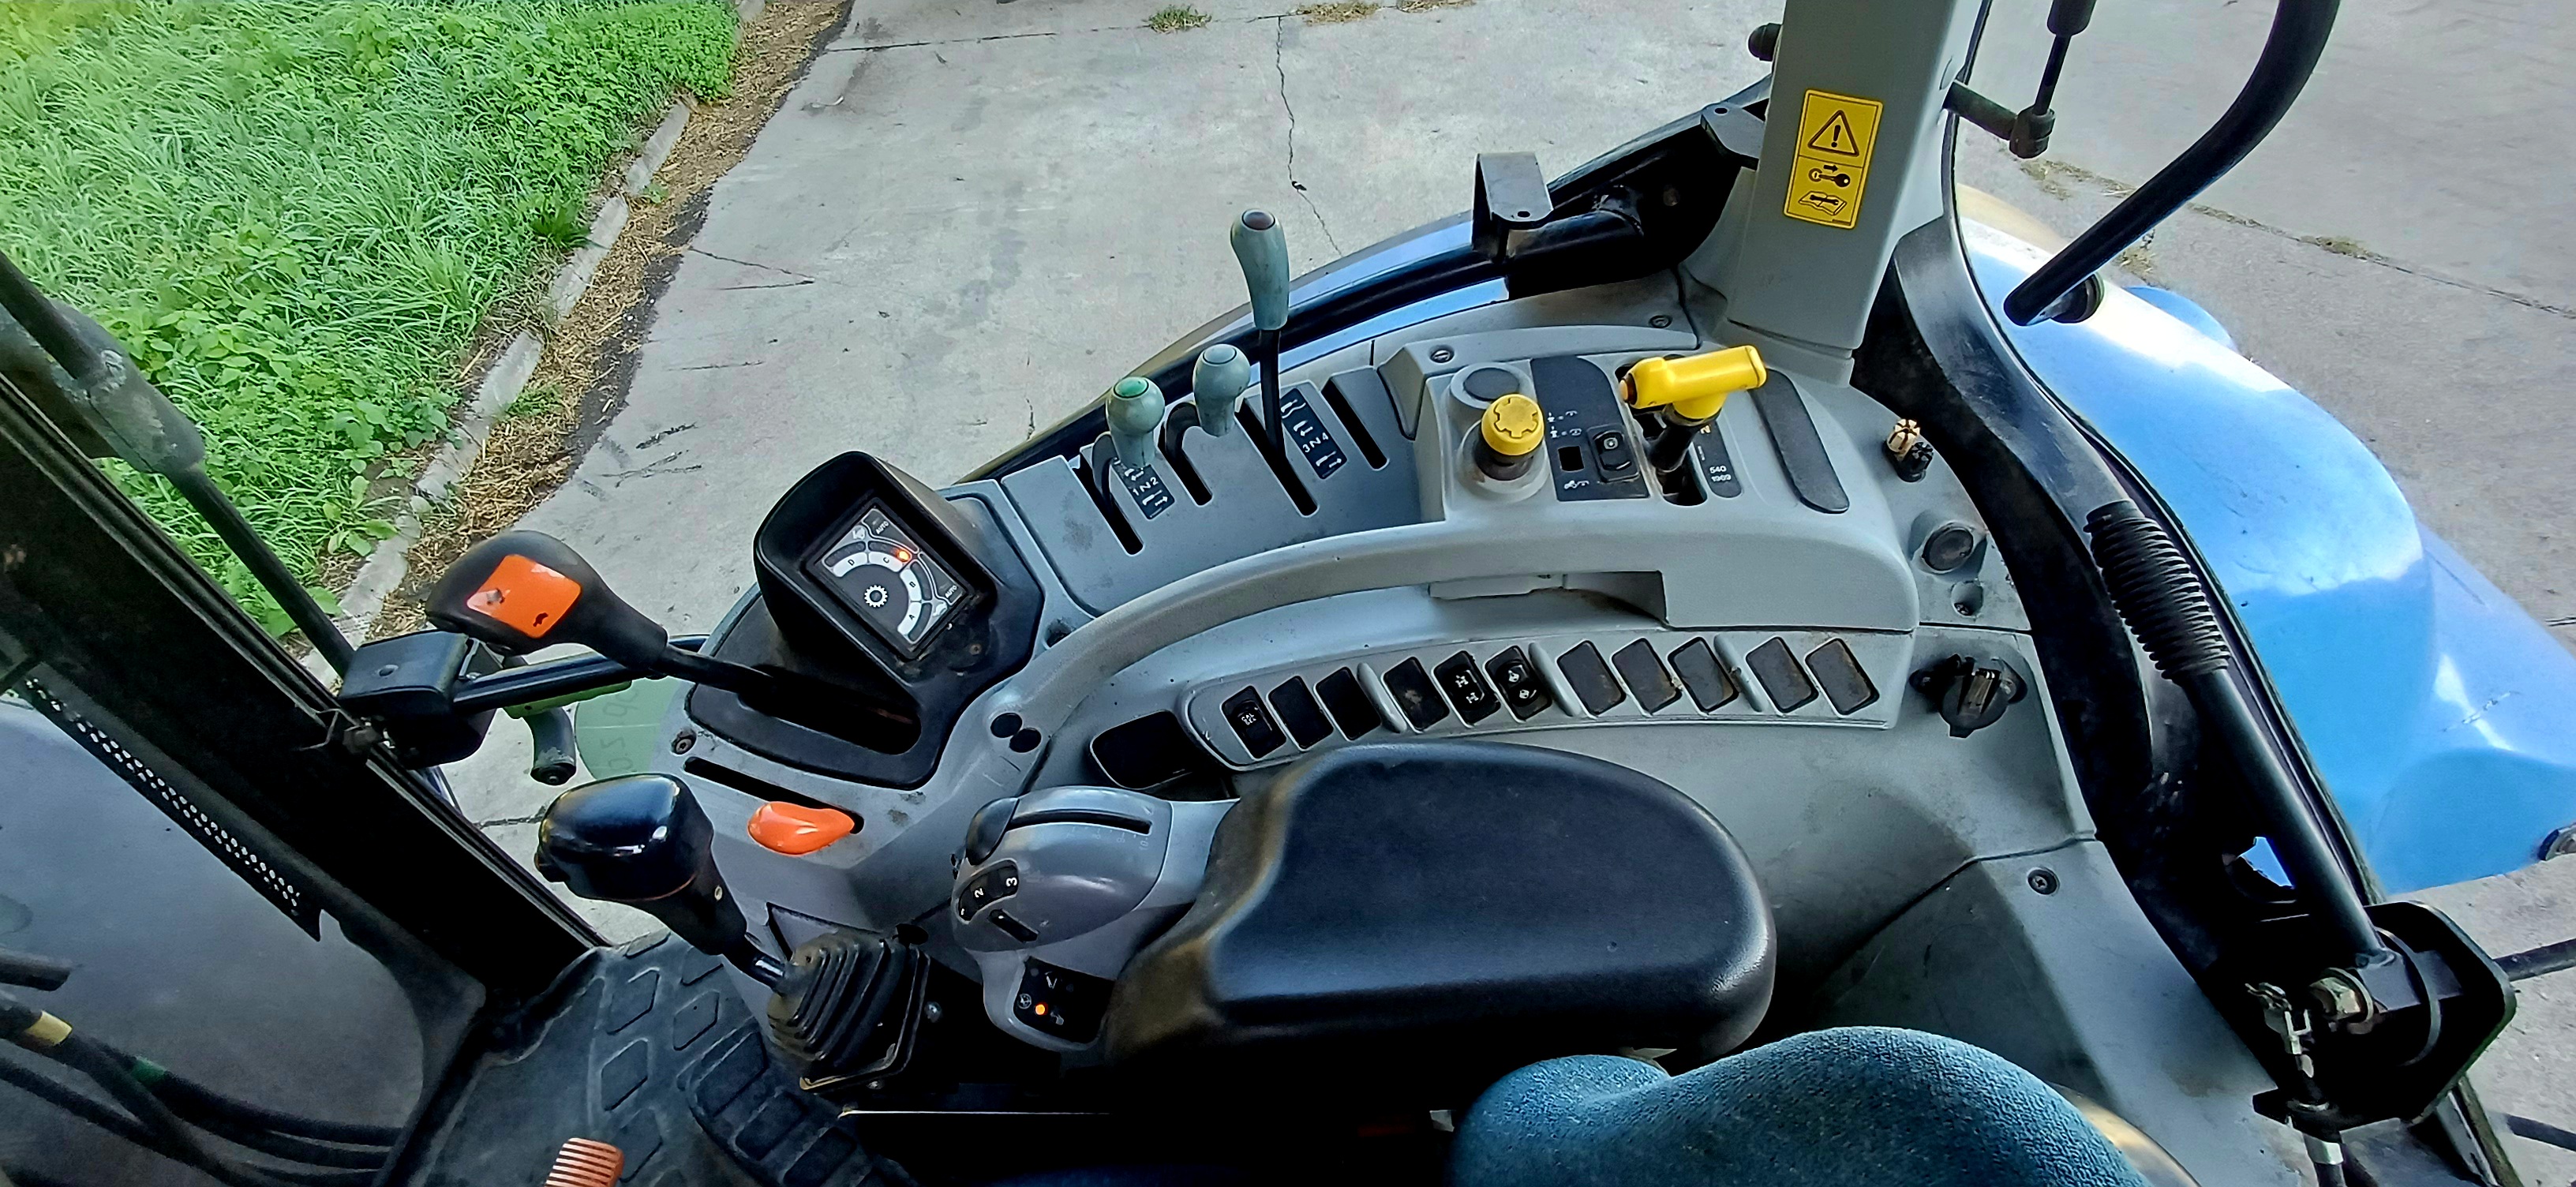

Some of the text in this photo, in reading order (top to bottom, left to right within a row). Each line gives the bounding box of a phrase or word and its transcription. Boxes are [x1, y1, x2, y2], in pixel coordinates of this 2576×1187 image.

[1309, 436, 1321, 448] N
[1709, 465, 1727, 474] 540
[1139, 481, 1151, 492] N
[1150, 477, 1159, 485] 2
[876, 521, 889, 534] AUTO
[945, 585, 957, 598] AUTO
[974, 888, 984, 898] 2
[1005, 877, 1017, 887] 3
